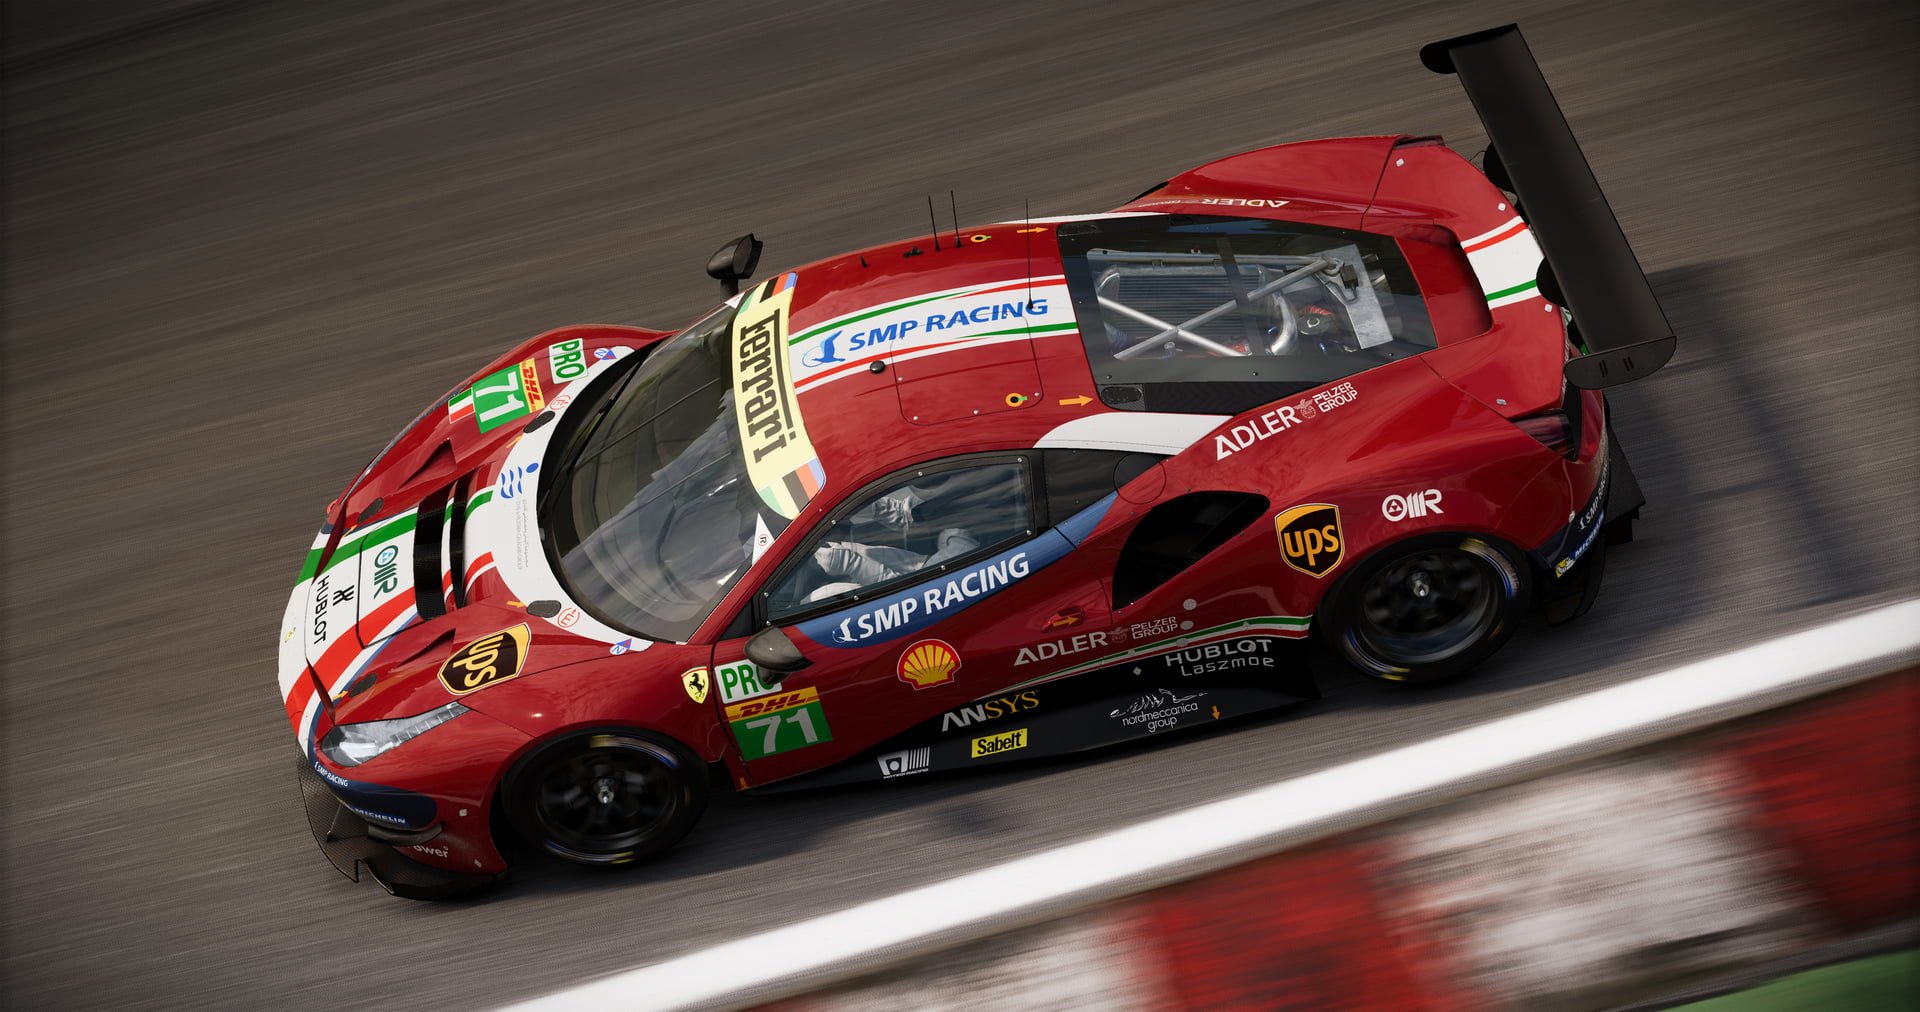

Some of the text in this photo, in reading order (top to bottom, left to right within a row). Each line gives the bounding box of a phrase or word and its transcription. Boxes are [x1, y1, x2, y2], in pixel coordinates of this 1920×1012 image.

[1201, 198, 1290, 208] ADLER
[849, 299, 1048, 351] SMP RACING
[551, 340, 585, 379] PRO
[475, 371, 525, 423] 71
[522, 366, 541, 405] DHL
[1312, 382, 1354, 404] PELZER
[1318, 390, 1358, 413] GROUP
[1214, 405, 1303, 462] ADLER
[857, 552, 1030, 639] SMP RACING
[313, 574, 330, 645] HUBLOT
[1131, 616, 1177, 633] PELZER
[1132, 624, 1178, 640] GROUP
[1013, 631, 1108, 667] ADLER
[1165, 639, 1273, 668] HUBLOT
[740, 693, 806, 719] DHL
[942, 690, 1040, 732] ANSYS
[1122, 702, 1198, 726] nordmeccanica
[745, 707, 818, 754] 71
[1147, 716, 1178, 733] group
[977, 731, 1021, 755] Sabelt
[317, 765, 348, 787] SMP RACING
[354, 808, 406, 824] MICHELIN
[407, 844, 449, 858] ower
